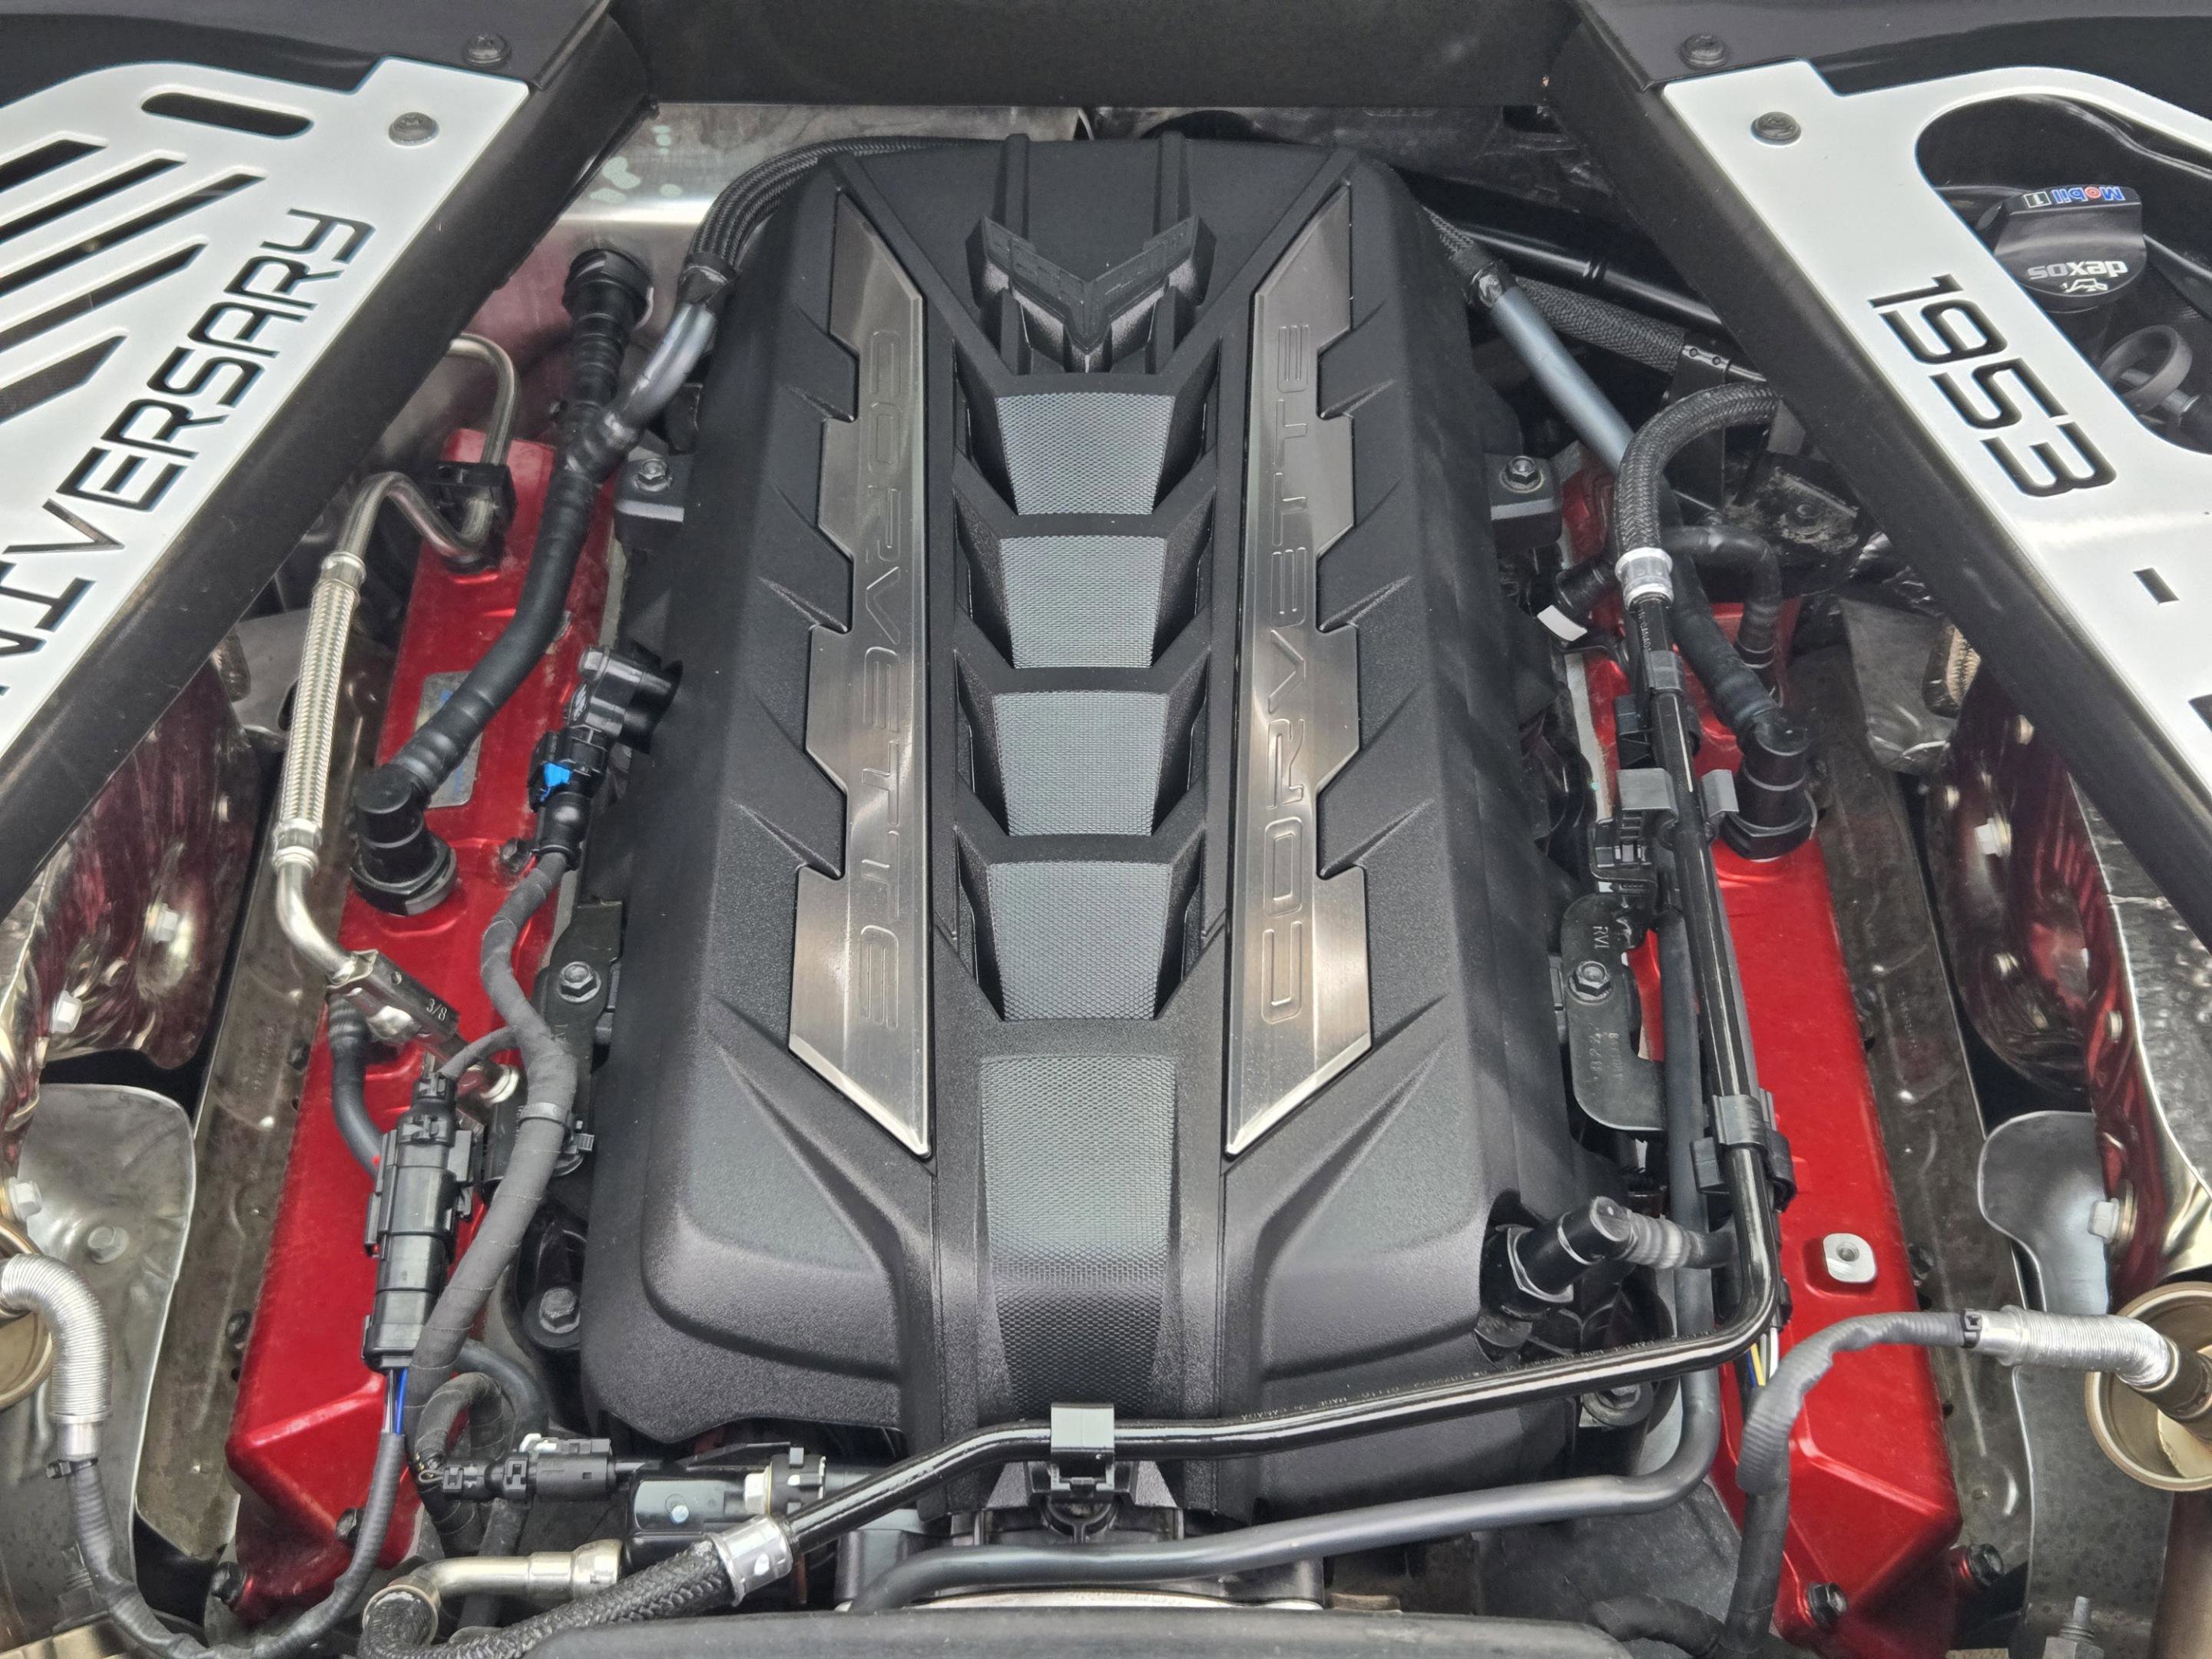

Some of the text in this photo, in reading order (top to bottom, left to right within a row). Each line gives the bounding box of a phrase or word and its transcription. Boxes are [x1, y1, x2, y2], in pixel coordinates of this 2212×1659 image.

[2051, 185, 2126, 204] Mobil
[2028, 260, 2128, 280] dexos
[1867, 273, 2118, 498] 1953
[860, 329, 902, 1031] CORVETTE
[1260, 323, 1311, 1025] CORVETTE
[426, 998, 447, 1022] 3/8
